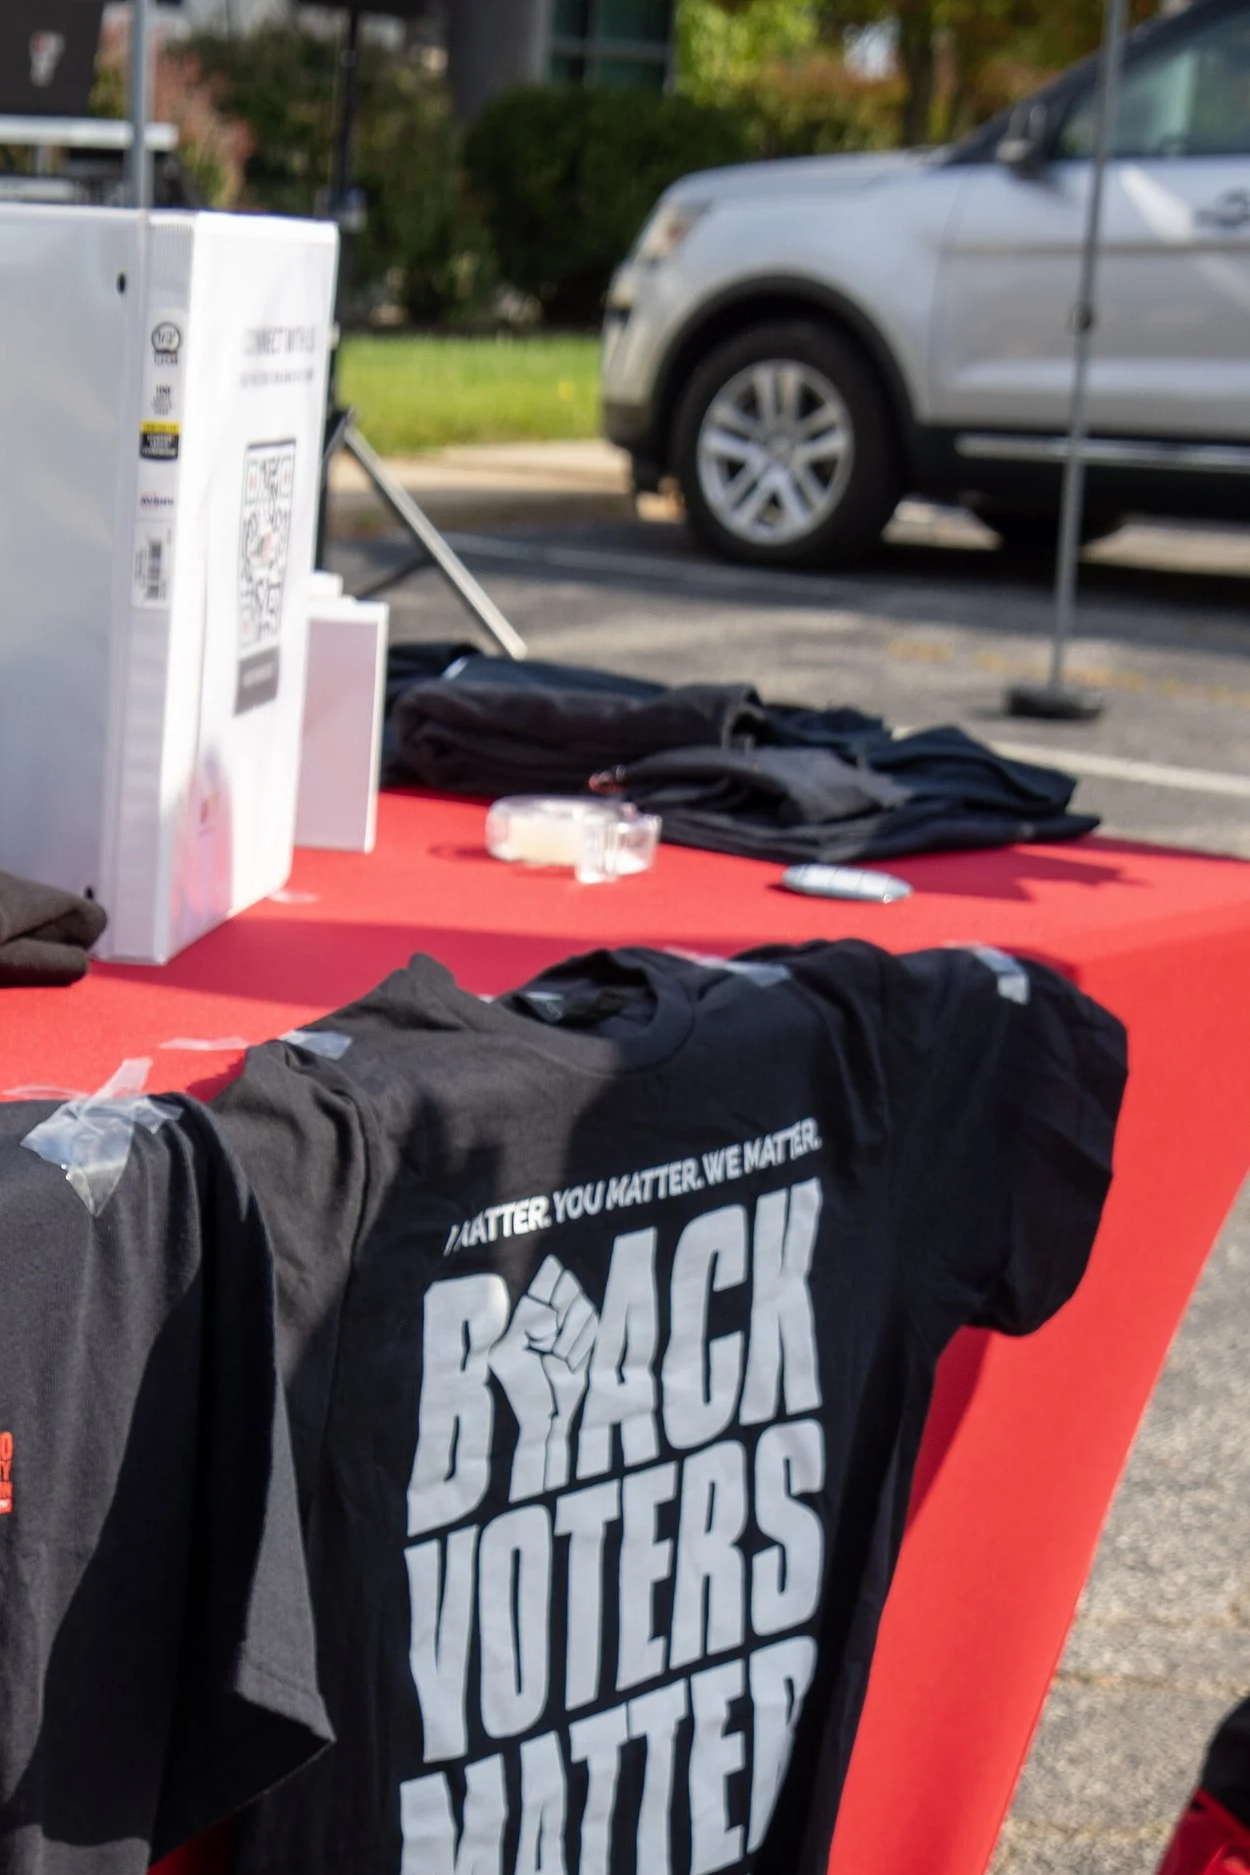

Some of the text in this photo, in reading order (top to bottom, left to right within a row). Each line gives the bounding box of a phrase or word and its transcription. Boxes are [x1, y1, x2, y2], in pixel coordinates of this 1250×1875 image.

[553, 1181, 607, 1223] YOU
[607, 1158, 704, 1211] MATTER.
[702, 1143, 743, 1185] WE
[743, 1117, 823, 1174] MATTER.
[404, 1418, 824, 1763] VOTERS
